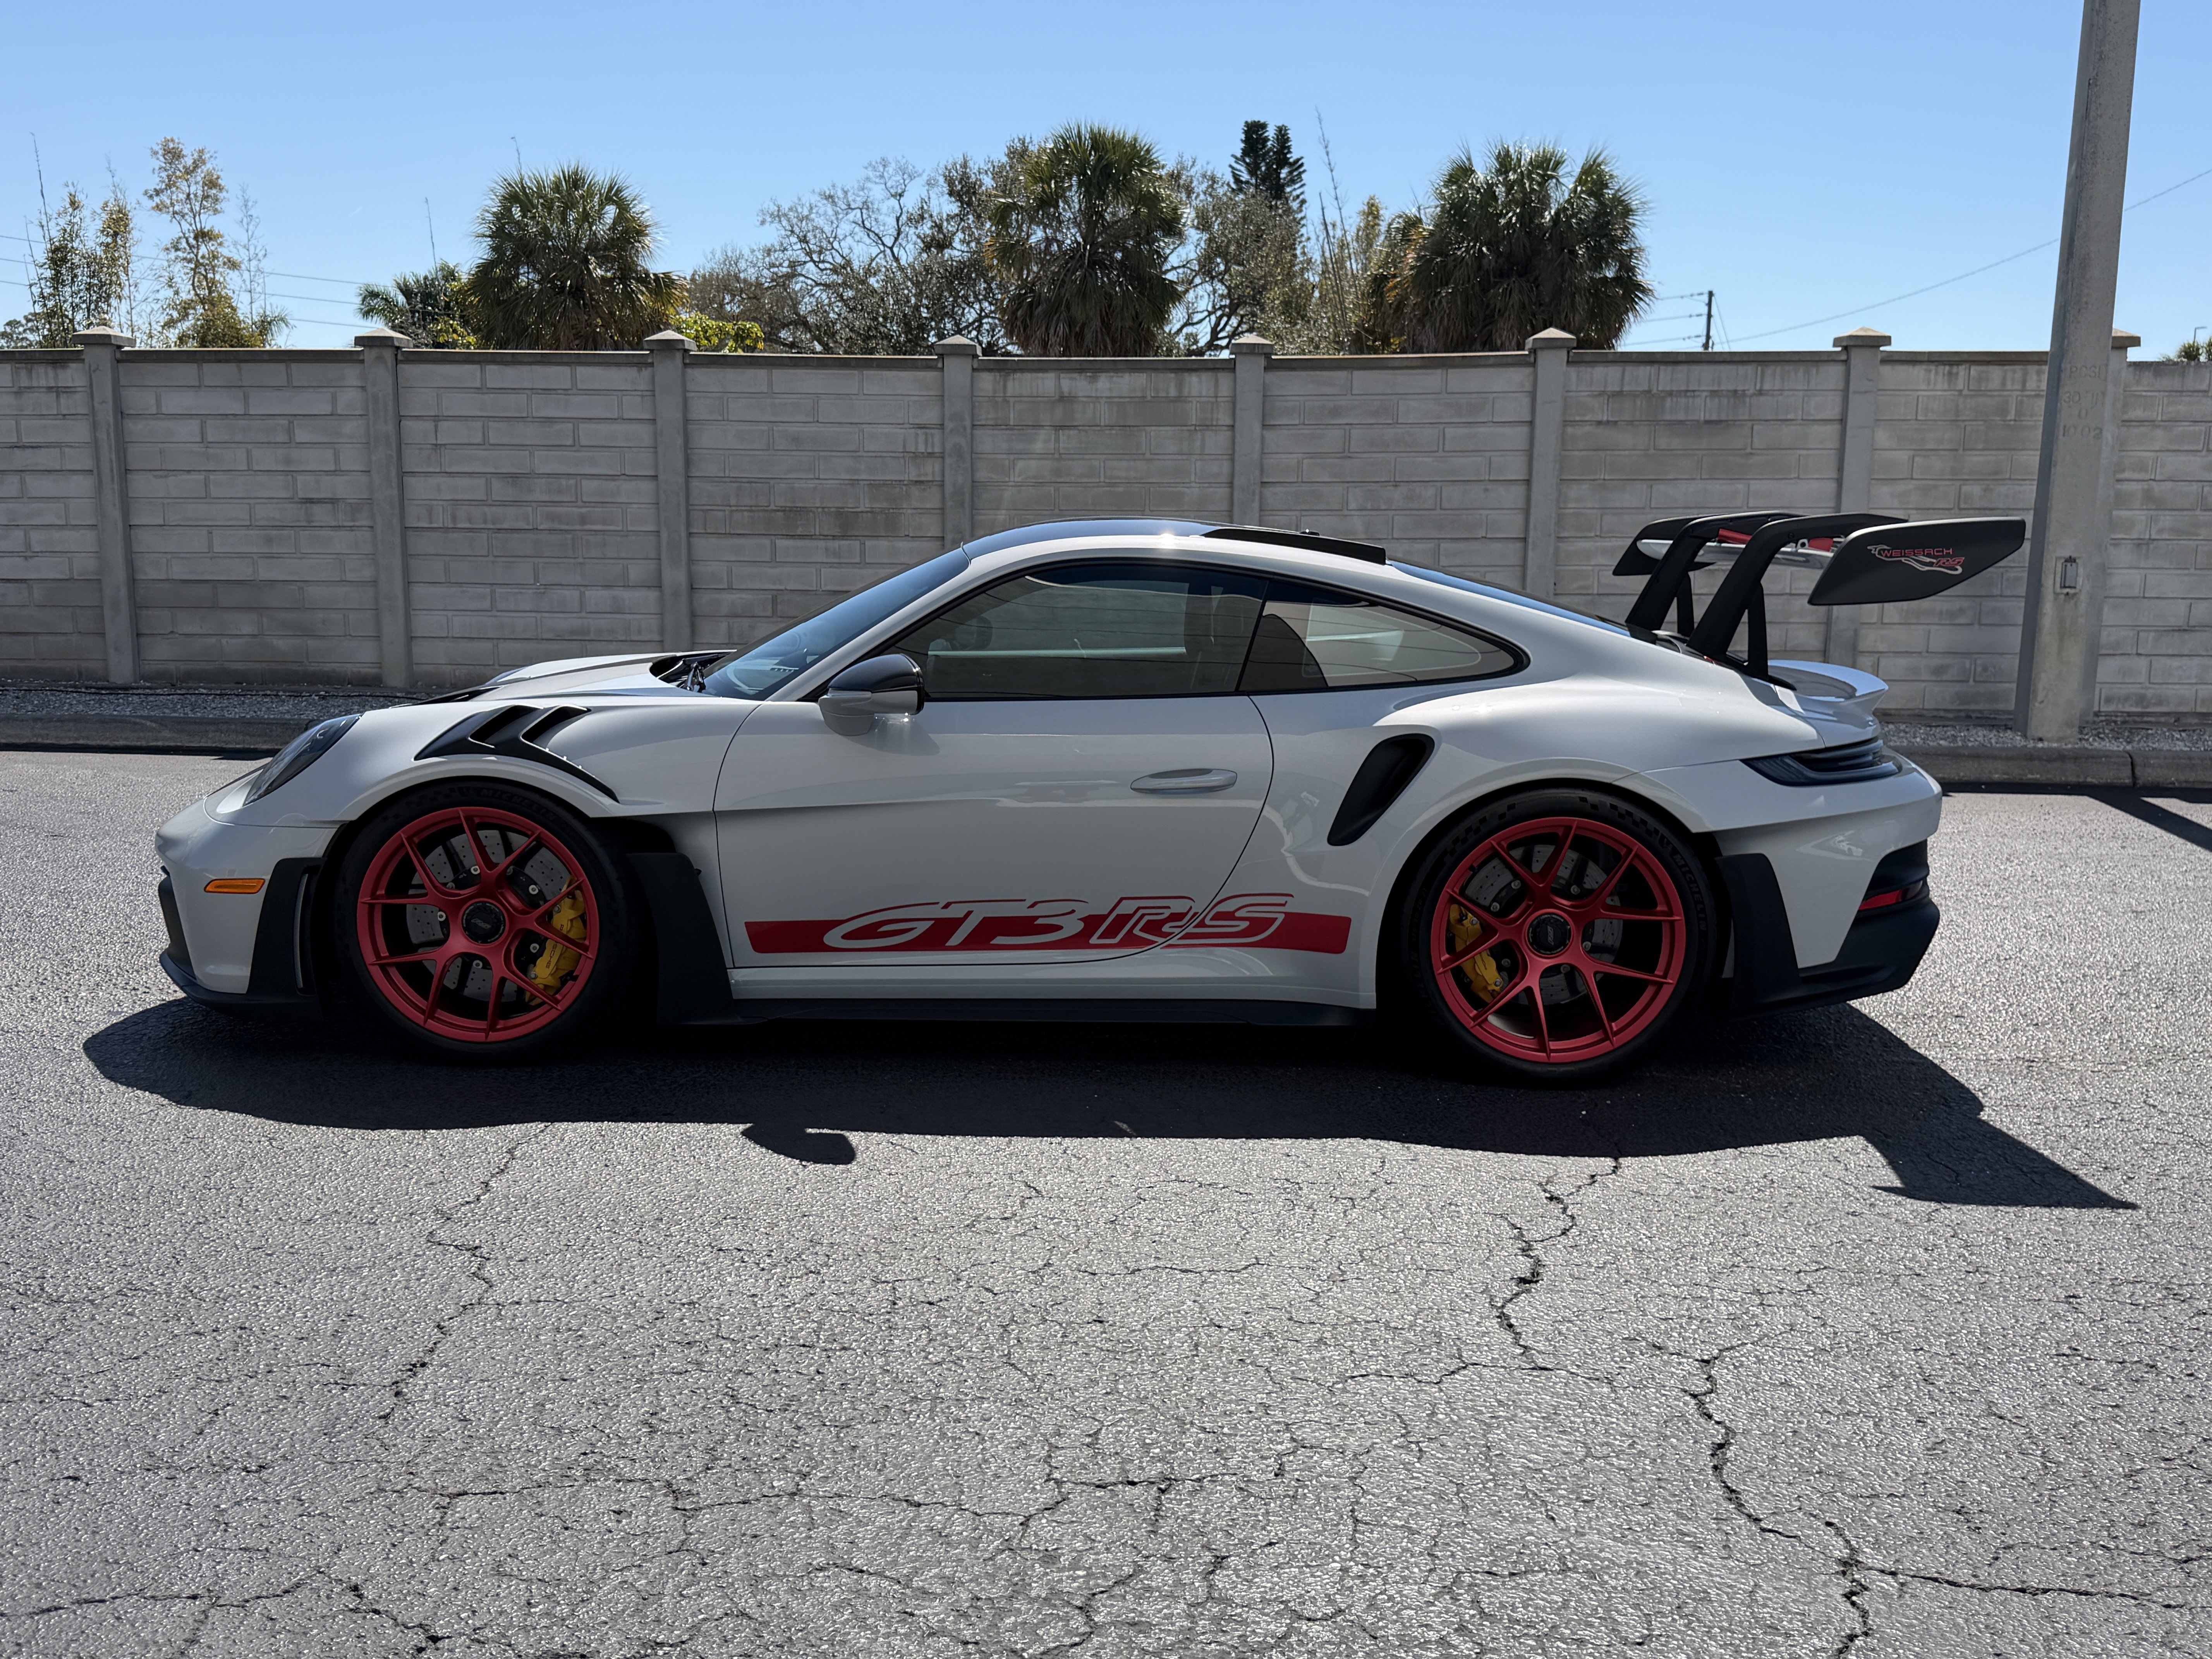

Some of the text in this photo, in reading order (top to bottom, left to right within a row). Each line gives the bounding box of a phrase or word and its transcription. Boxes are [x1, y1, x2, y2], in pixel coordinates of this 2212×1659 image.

[1881, 548, 1953, 557] WEISSACH
[1933, 557, 1965, 567] RS
[481, 788, 558, 821] MICHELIN
[1673, 854, 1707, 931] MICHELIN
[546, 924, 564, 969] PSCHE
